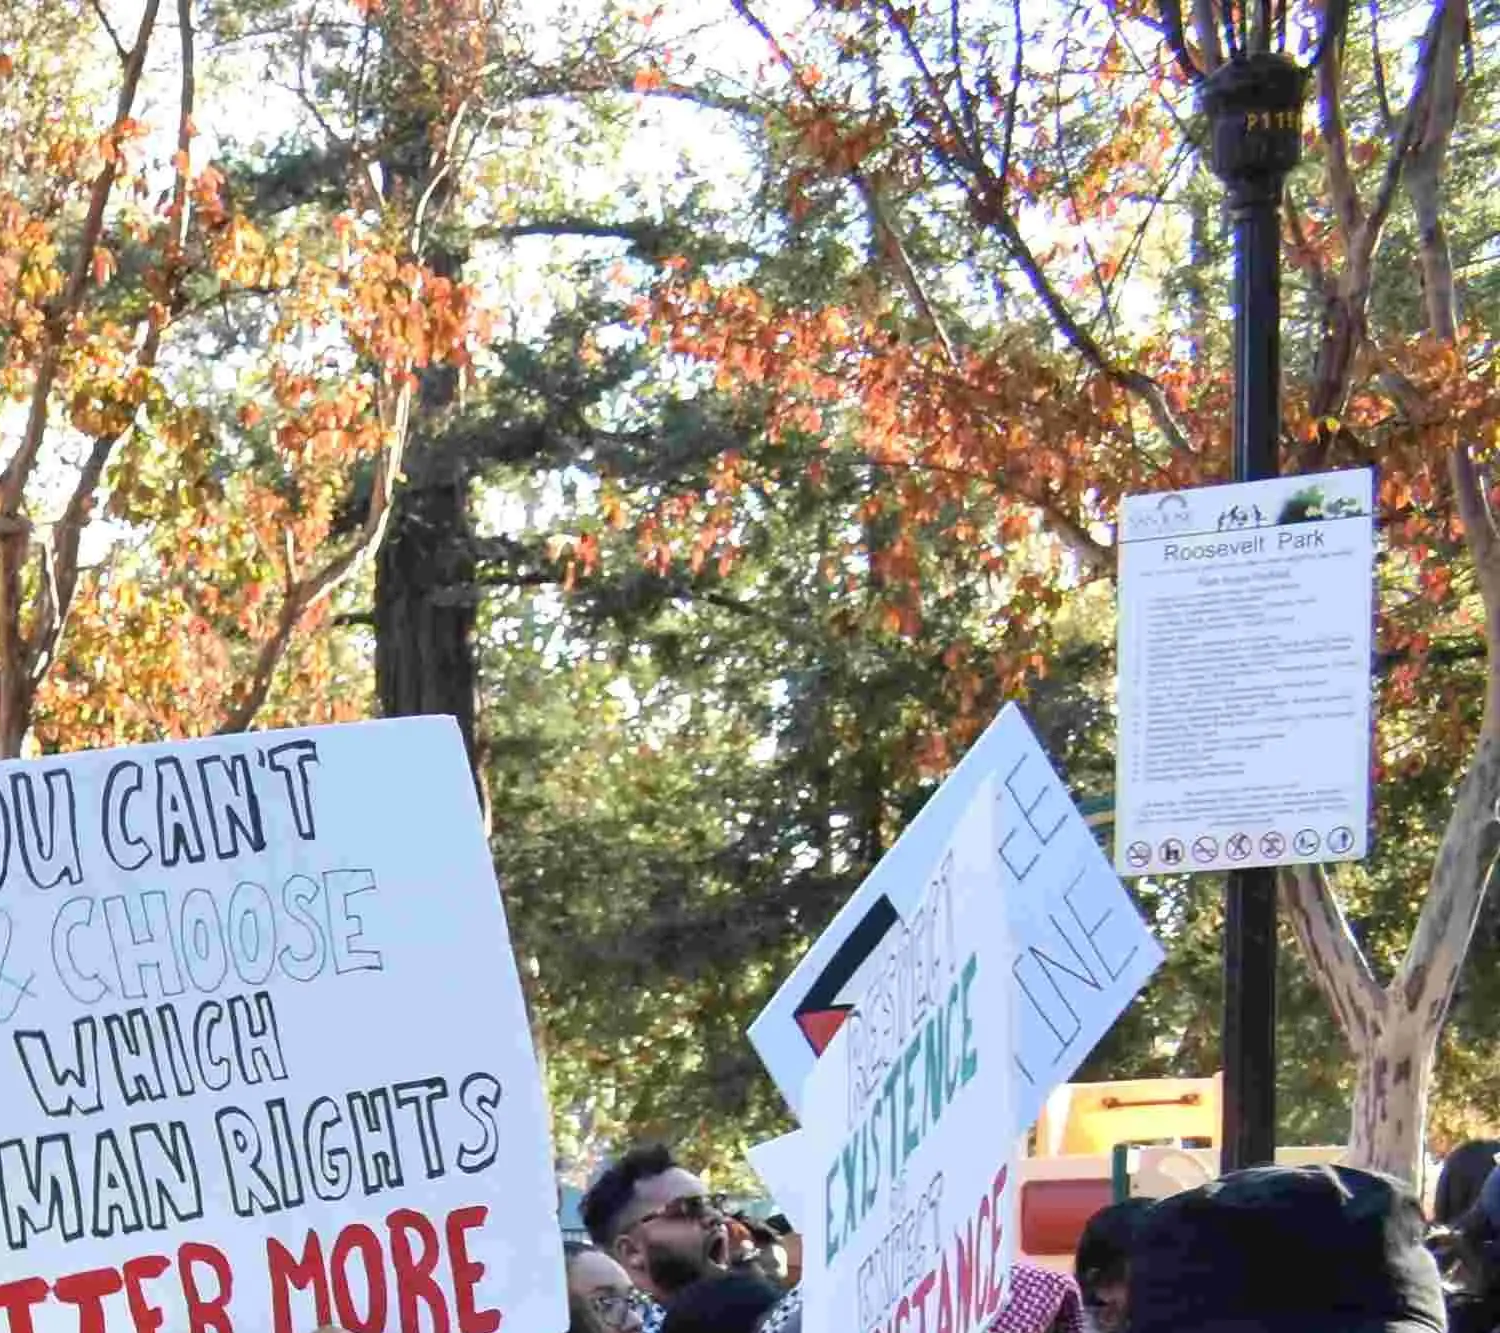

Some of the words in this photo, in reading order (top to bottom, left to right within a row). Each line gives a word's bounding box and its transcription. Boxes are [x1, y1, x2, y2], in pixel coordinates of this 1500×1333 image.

[1163, 536, 1264, 562] Roosevelt
[1277, 529, 1326, 551] Park
[100, 739, 320, 870] CAN'T
[50, 868, 384, 1006] CHOOSE
[845, 848, 957, 1132] RESPECT
[13, 990, 290, 1118] WHICH
[825, 952, 978, 1270] EXISTENCE
[214, 1072, 503, 1218] RIGHTS
